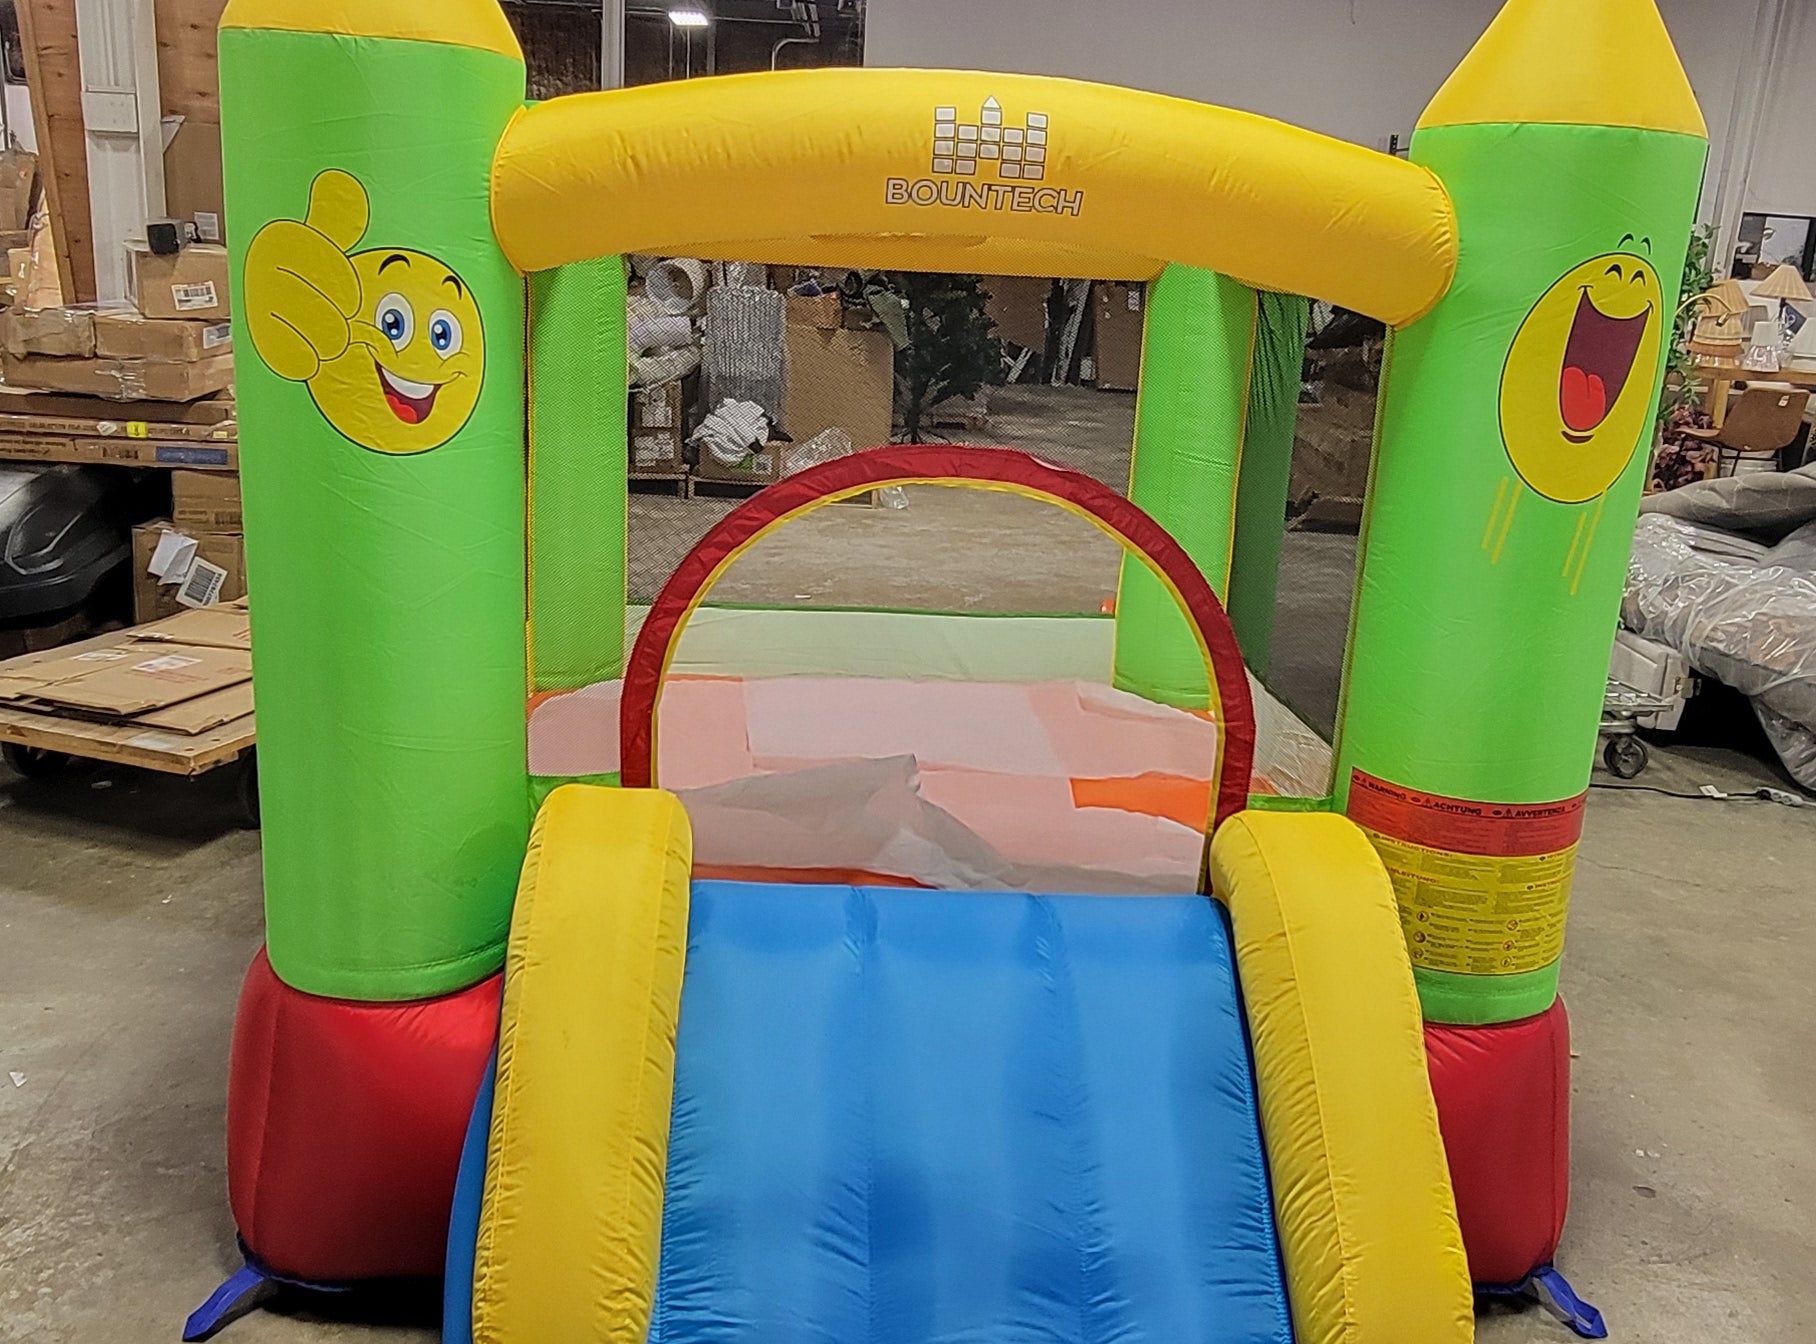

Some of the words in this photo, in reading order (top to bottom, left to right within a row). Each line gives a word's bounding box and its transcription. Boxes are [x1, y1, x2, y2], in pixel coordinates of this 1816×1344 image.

[886, 177, 1083, 216] BOUNTECH
[1368, 781, 1407, 801] WARNING
[1433, 801, 1482, 816] ACHTUNG
